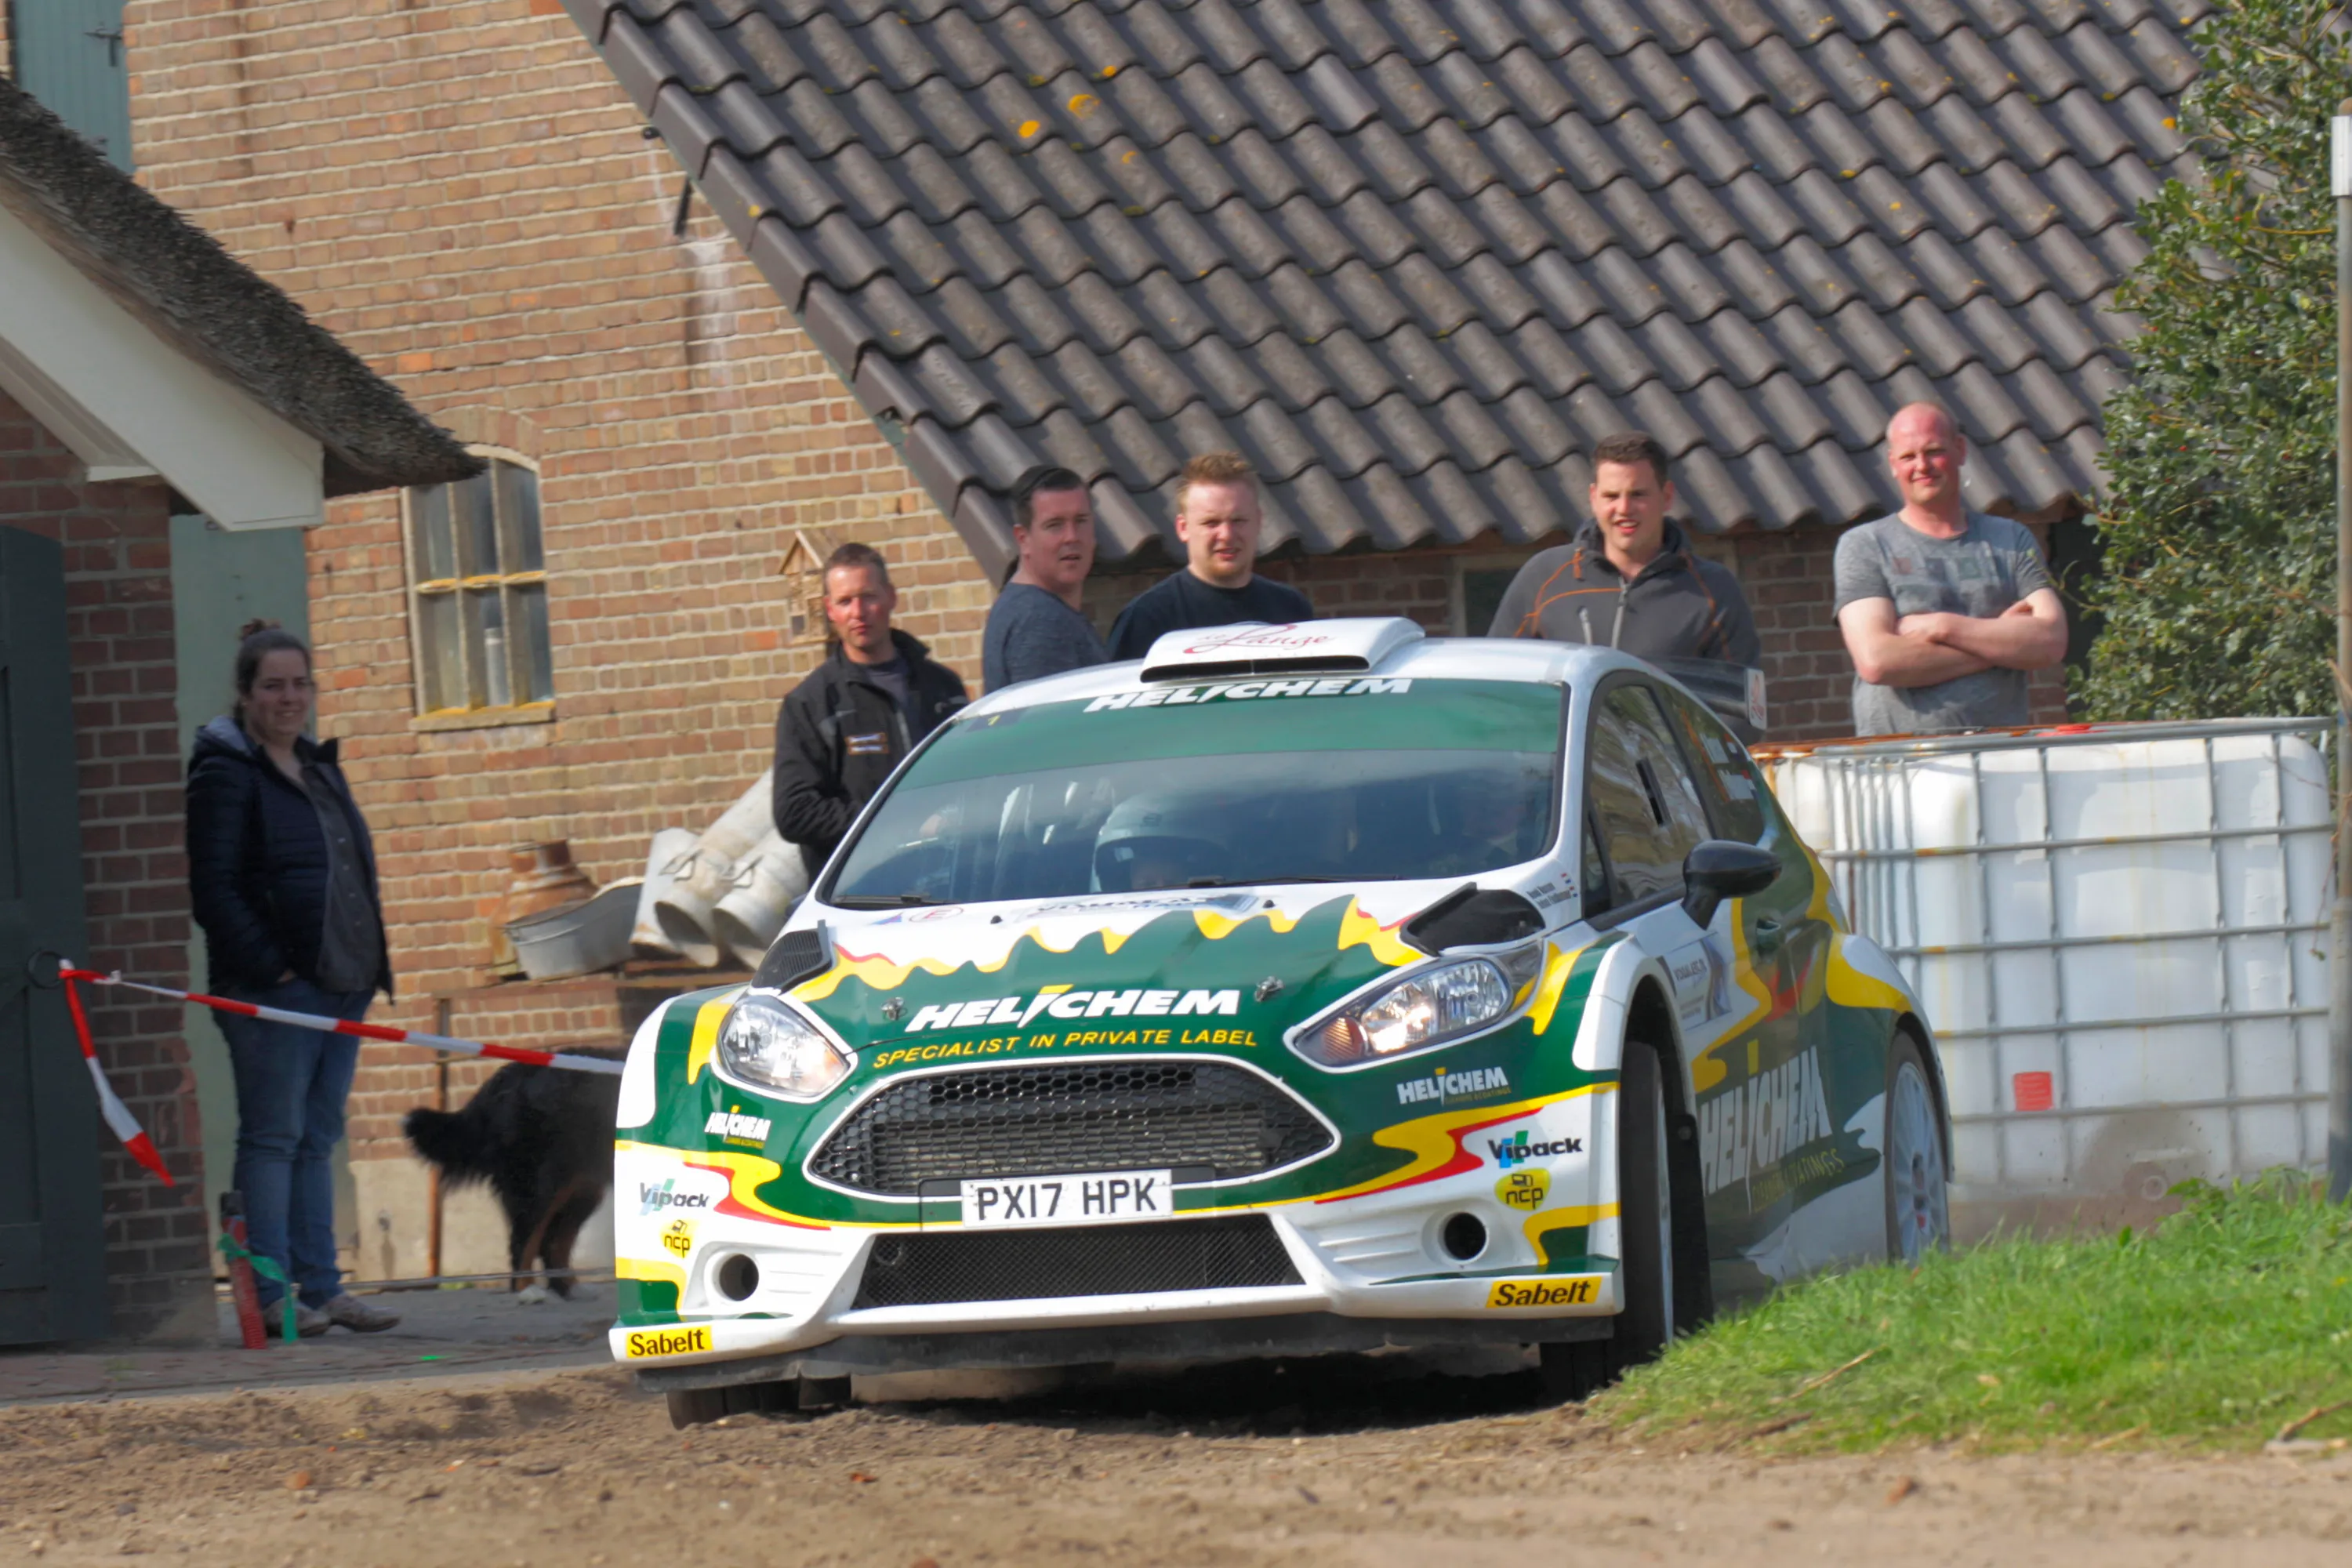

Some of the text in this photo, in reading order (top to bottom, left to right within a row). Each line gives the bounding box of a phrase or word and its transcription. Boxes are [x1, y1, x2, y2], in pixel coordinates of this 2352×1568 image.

[1083, 678, 1412, 712] HELICHEM
[905, 984, 1241, 1033] HELICHEM
[873, 1029, 1258, 1069] SPECIALIST IN PRIVATE LABEL
[1396, 1066, 1509, 1107] HELICHEM
[704, 1105, 771, 1142] HELICHEM
[1700, 1039, 1833, 1214] HELICHEM
[1487, 1136, 1583, 1163] Vipack
[640, 1180, 710, 1211] Vipack
[977, 1178, 1157, 1221] PX17 HPK
[1505, 1187, 1544, 1210] ncp
[664, 1235, 691, 1258] ncp
[1494, 1279, 1592, 1307] Sabelt
[630, 1329, 705, 1356] Sabelt
